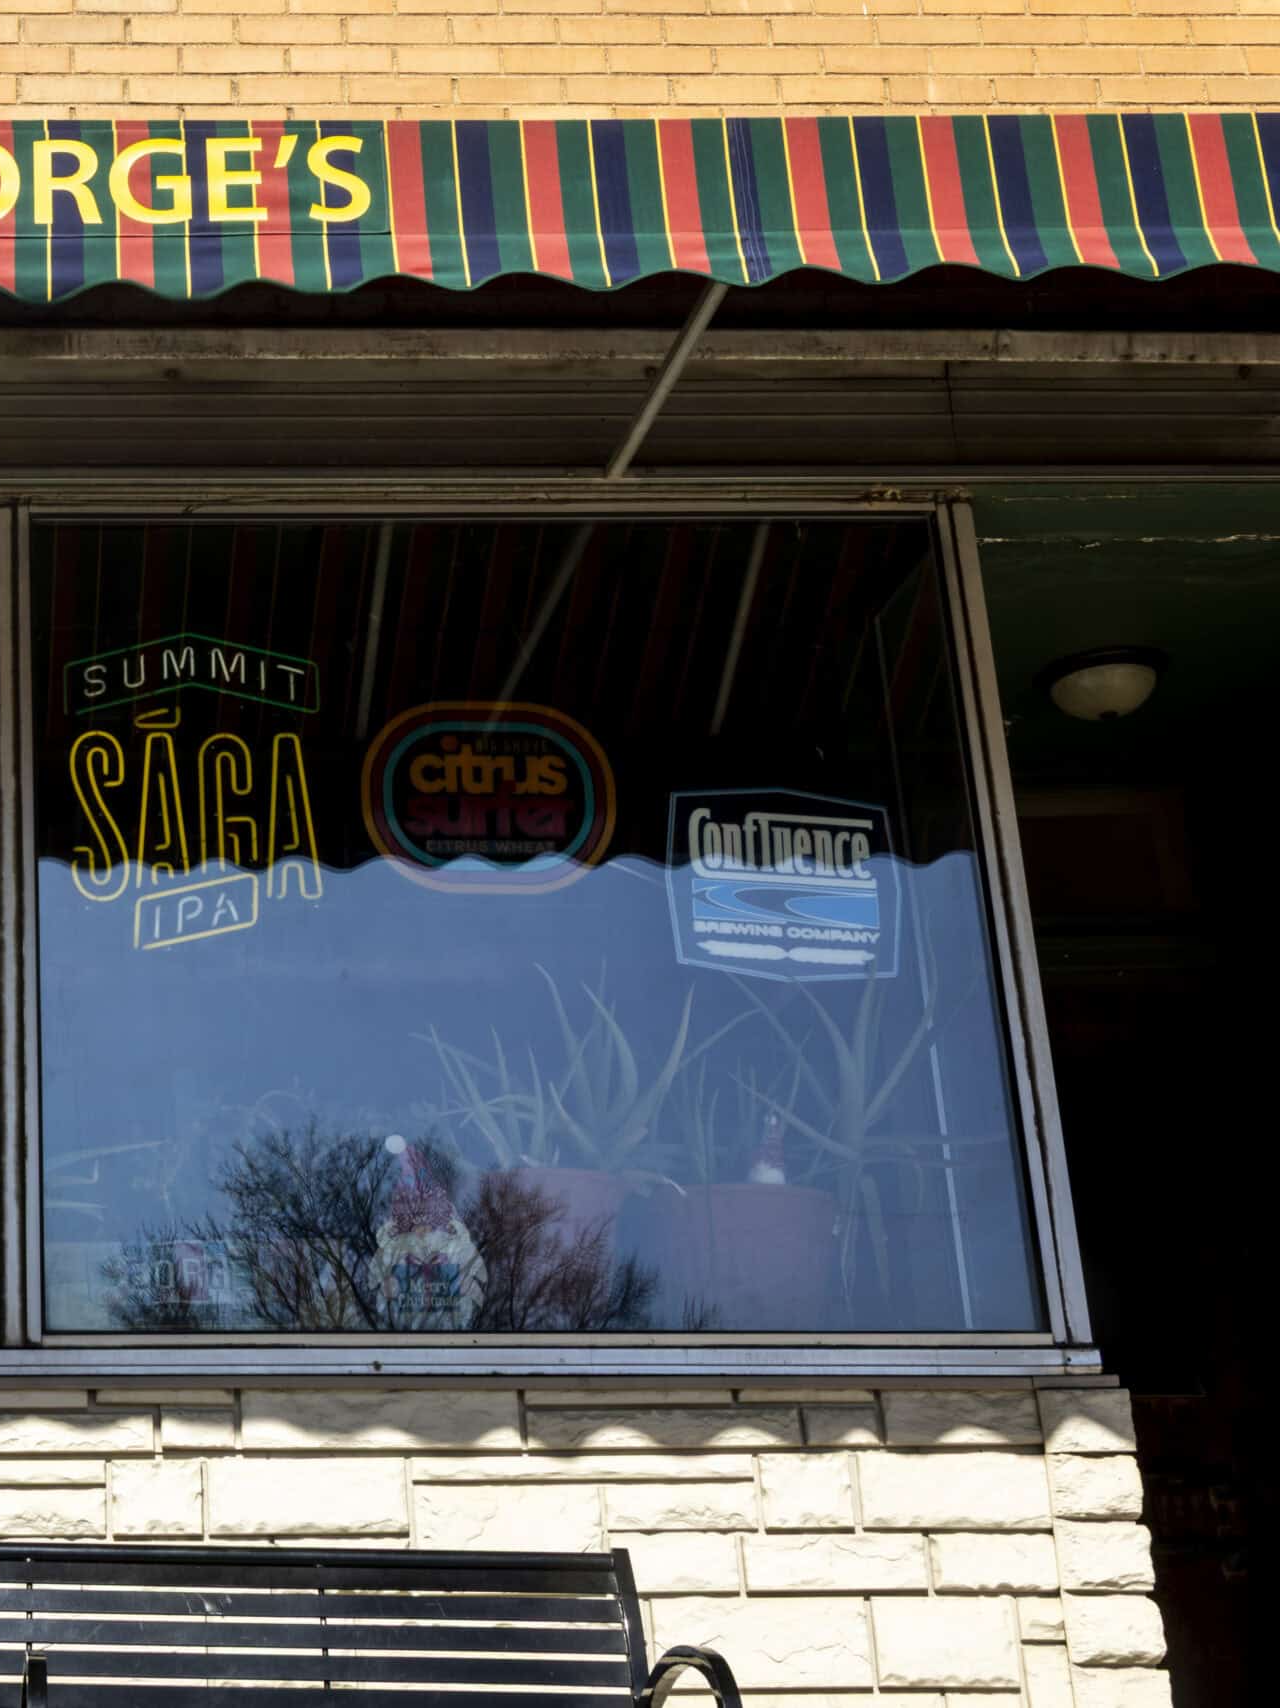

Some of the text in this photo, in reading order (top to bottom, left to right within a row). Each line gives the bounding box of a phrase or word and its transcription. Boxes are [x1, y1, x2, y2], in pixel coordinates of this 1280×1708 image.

[83, 646, 305, 702] SUMMIT
[409, 735, 569, 796] citrus
[425, 840, 490, 853] CITRUS
[688, 807, 877, 889] Confluence
[152, 893, 239, 939] IPA
[692, 919, 881, 944] BREWING COMPANY
